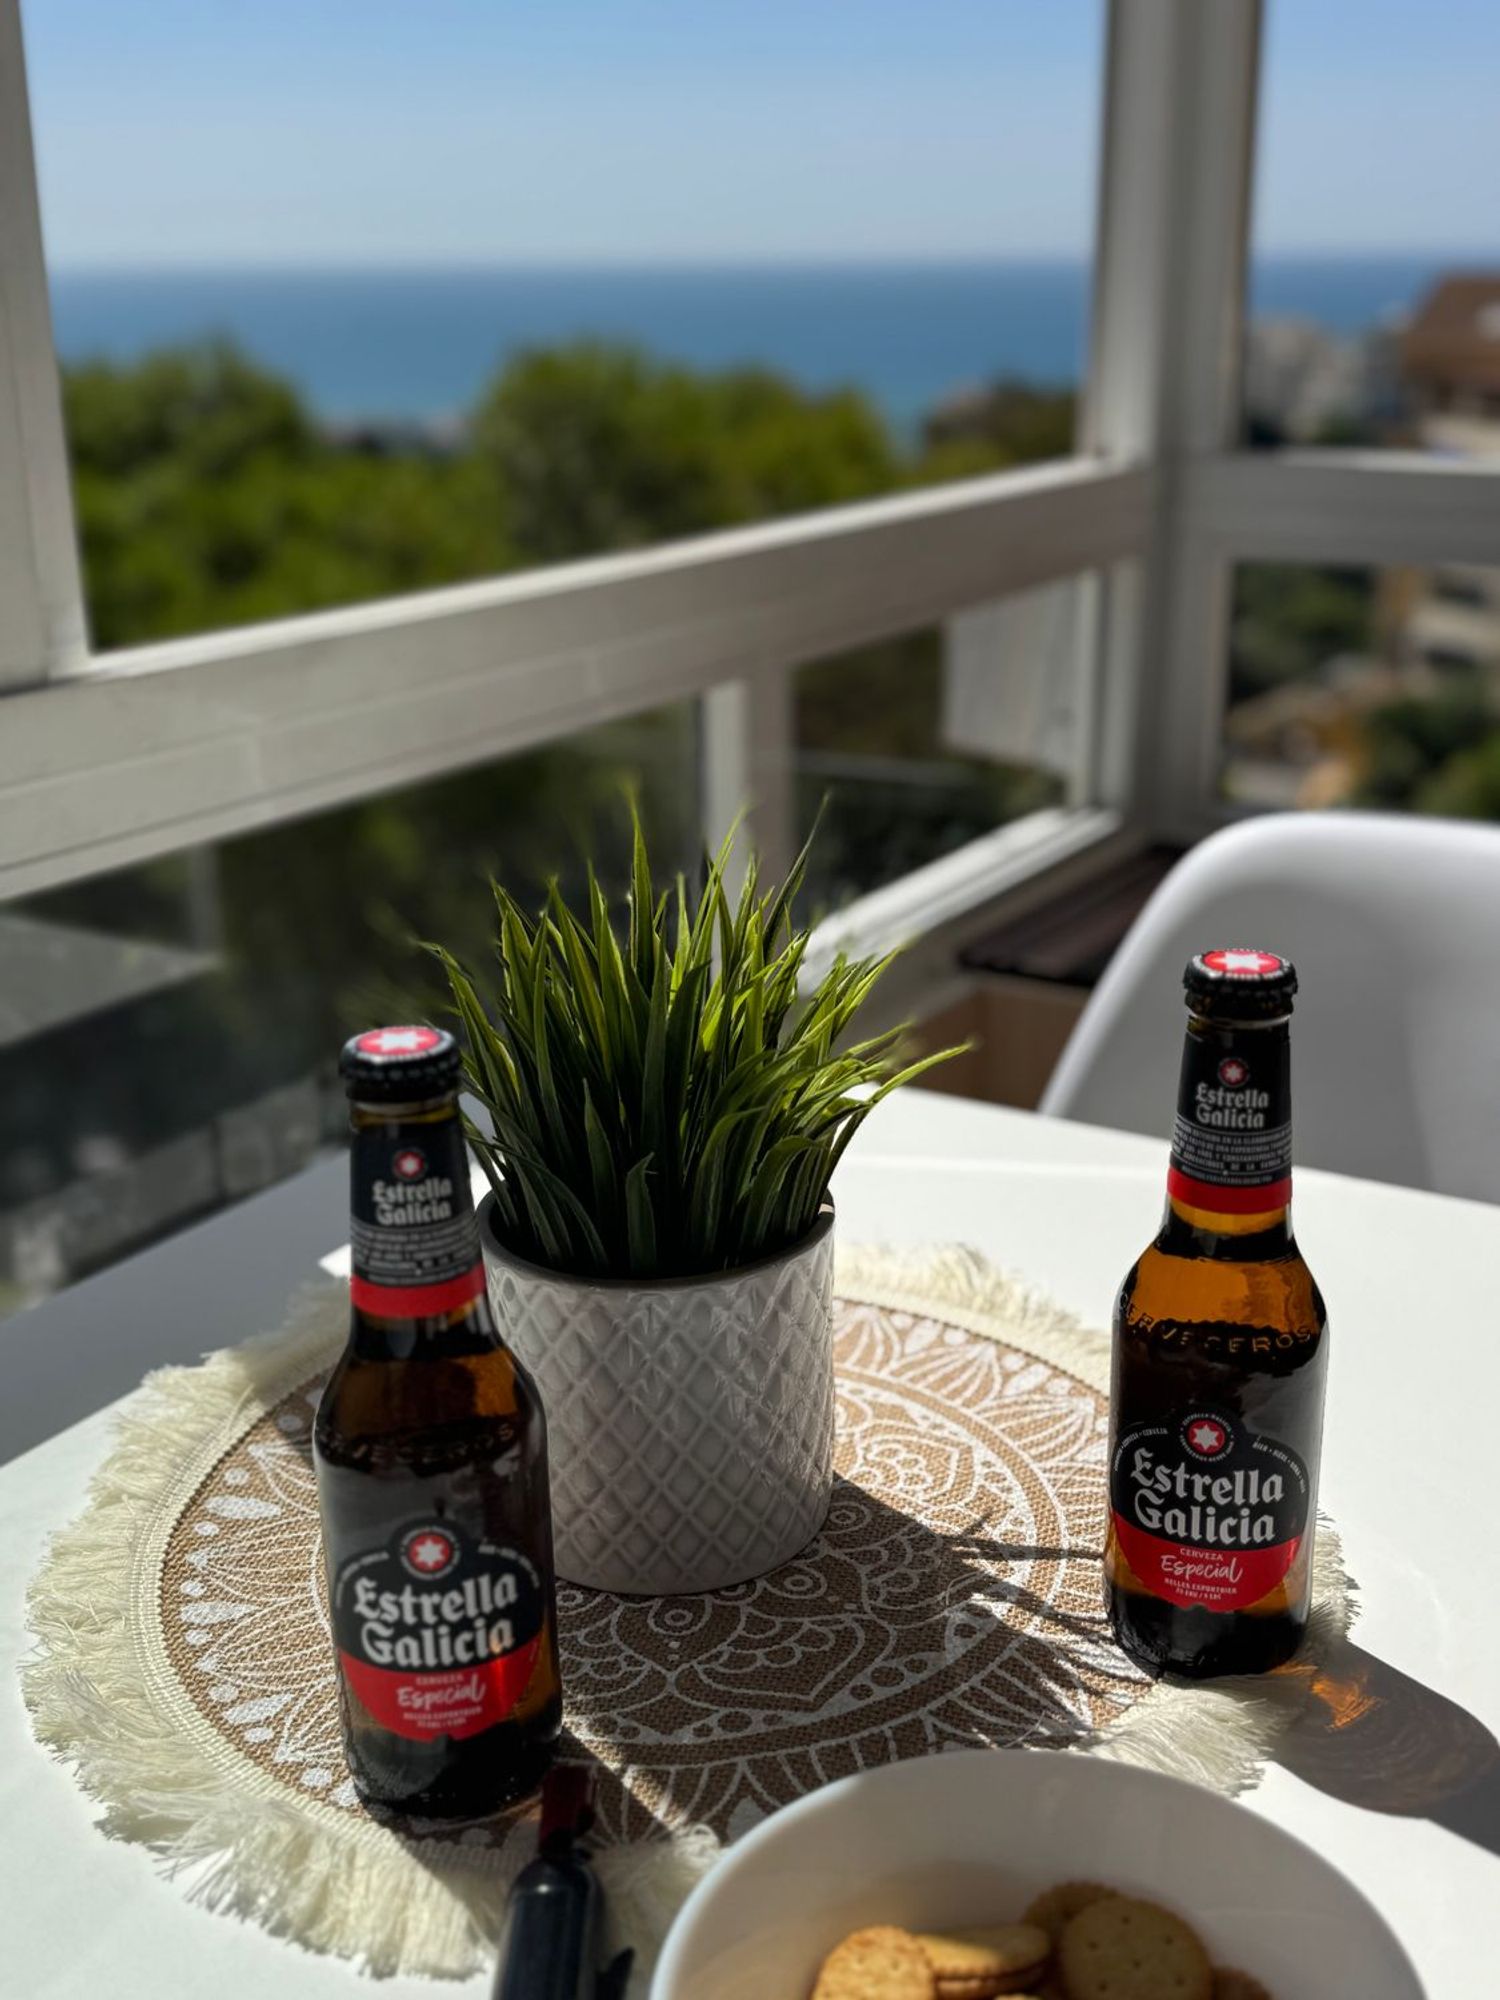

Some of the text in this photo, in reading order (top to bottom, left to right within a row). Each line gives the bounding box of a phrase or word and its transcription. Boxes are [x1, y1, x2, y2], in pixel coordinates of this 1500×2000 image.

[1195, 1082, 1269, 1108] Estrella
[1196, 1103, 1265, 1128] Galicia
[372, 1176, 453, 1202] Estrella
[375, 1201, 452, 1227] Galicia
[1130, 1447, 1285, 1506] Estrella
[1134, 1488, 1276, 1545] Galicia
[1180, 1547, 1224, 1561] CERVEZA
[1160, 1555, 1244, 1584] Especial
[354, 1572, 519, 1625] Estrella
[361, 1617, 515, 1669] Galicia
[396, 1673, 487, 1711] Especial
